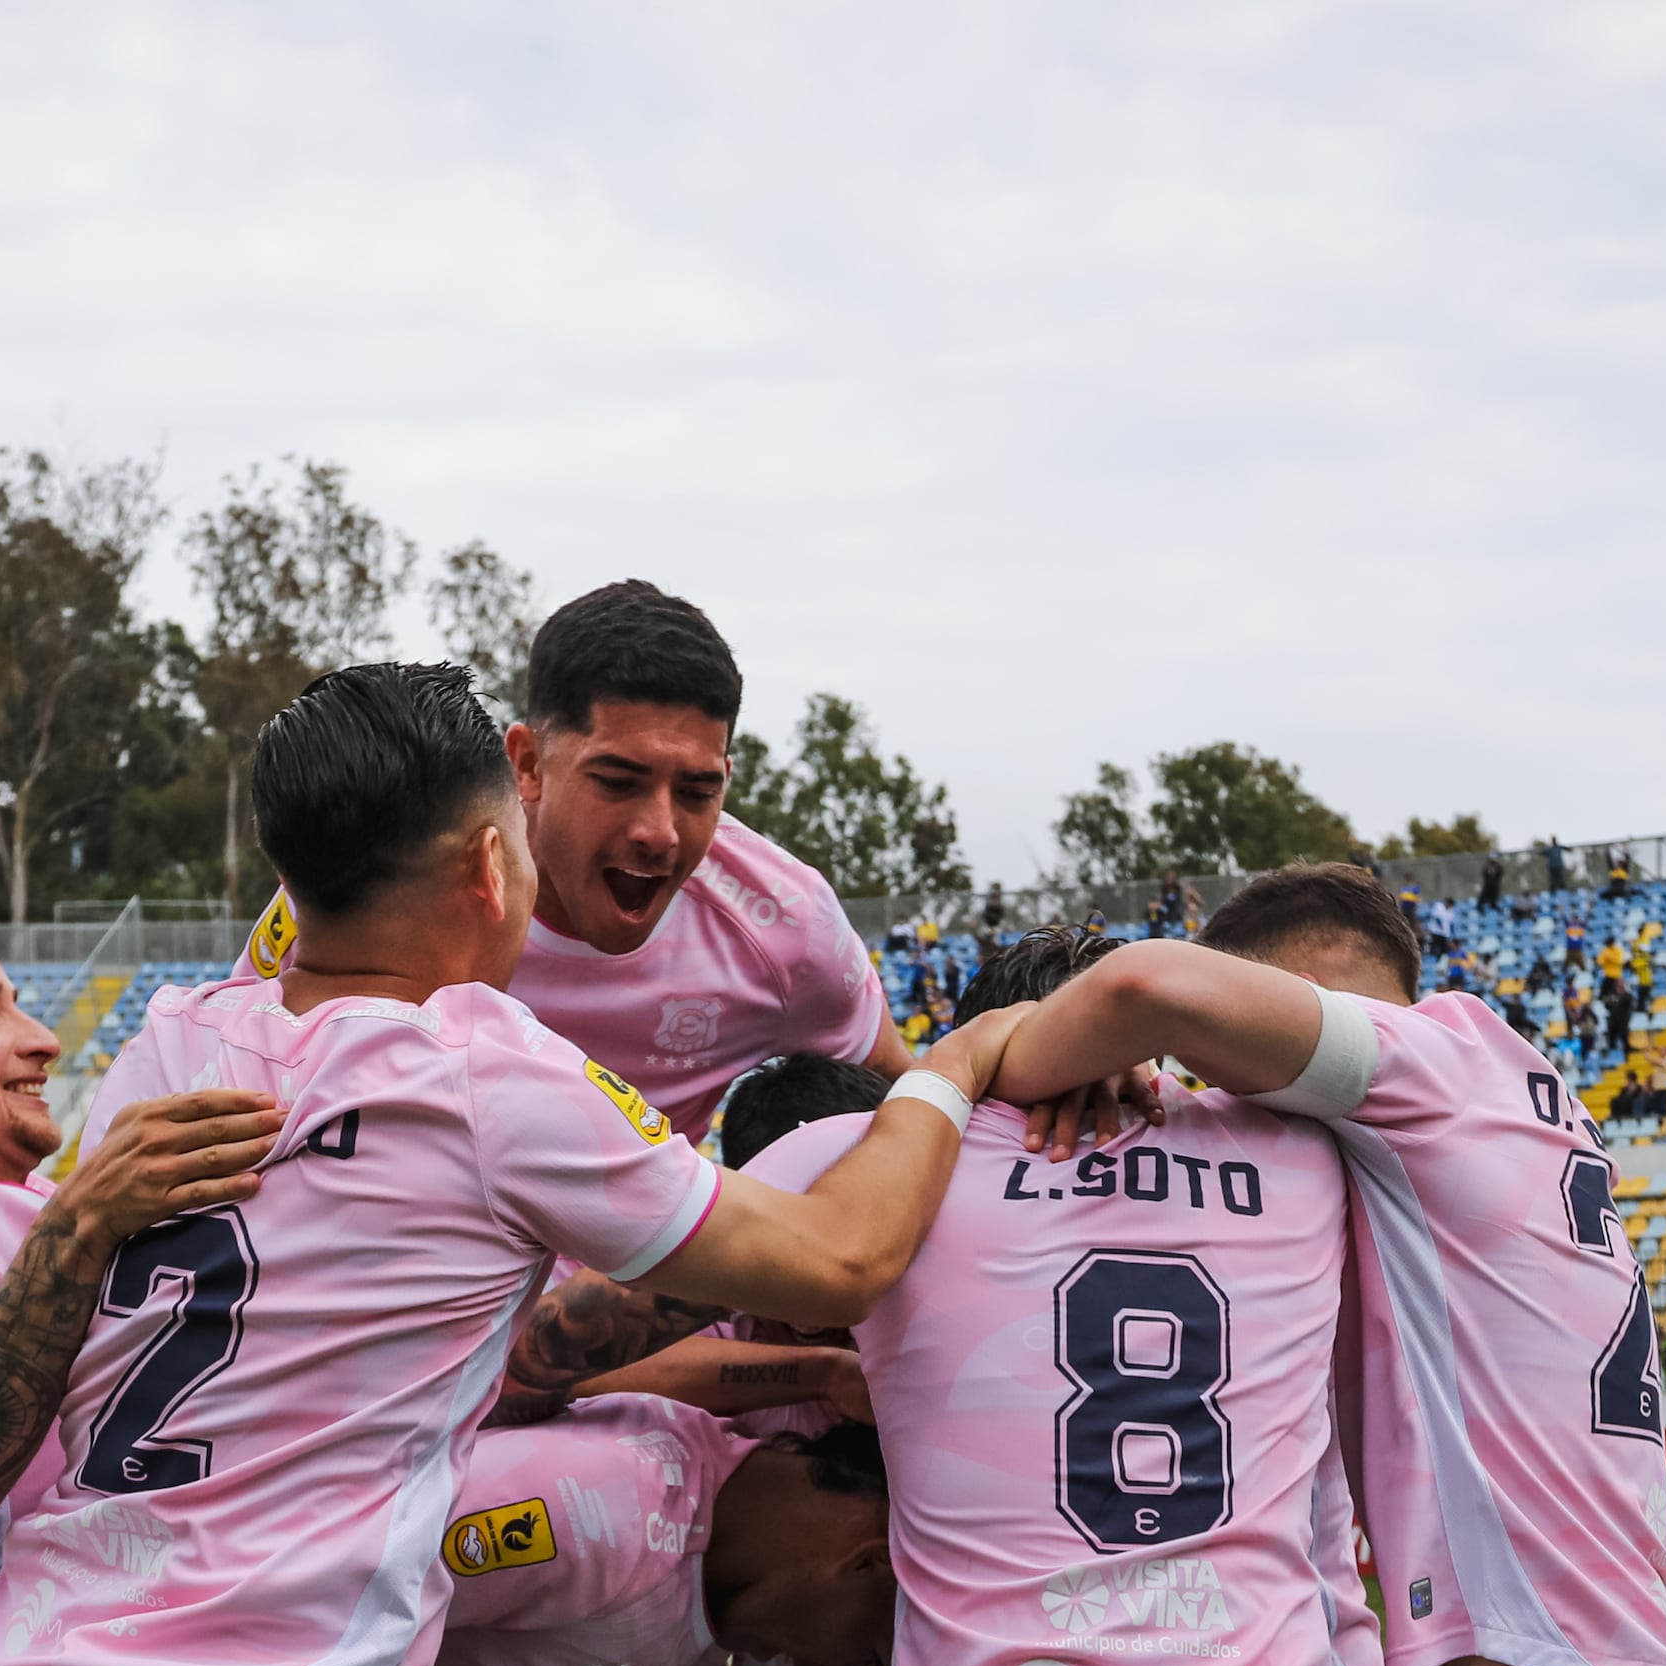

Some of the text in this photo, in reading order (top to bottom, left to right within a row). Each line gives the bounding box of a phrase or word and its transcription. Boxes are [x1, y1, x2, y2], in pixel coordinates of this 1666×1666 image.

[1003, 1146, 1263, 1217] L.SOTO
[75, 1202, 261, 1494] 2
[1053, 1246, 1234, 1556] 8
[645, 1510, 693, 1555] Clar
[1112, 1559, 1222, 1591] VISITA
[1118, 1590, 1236, 1632] VIÑA
[1035, 1633, 1242, 1660] unicipio de Cuidados
